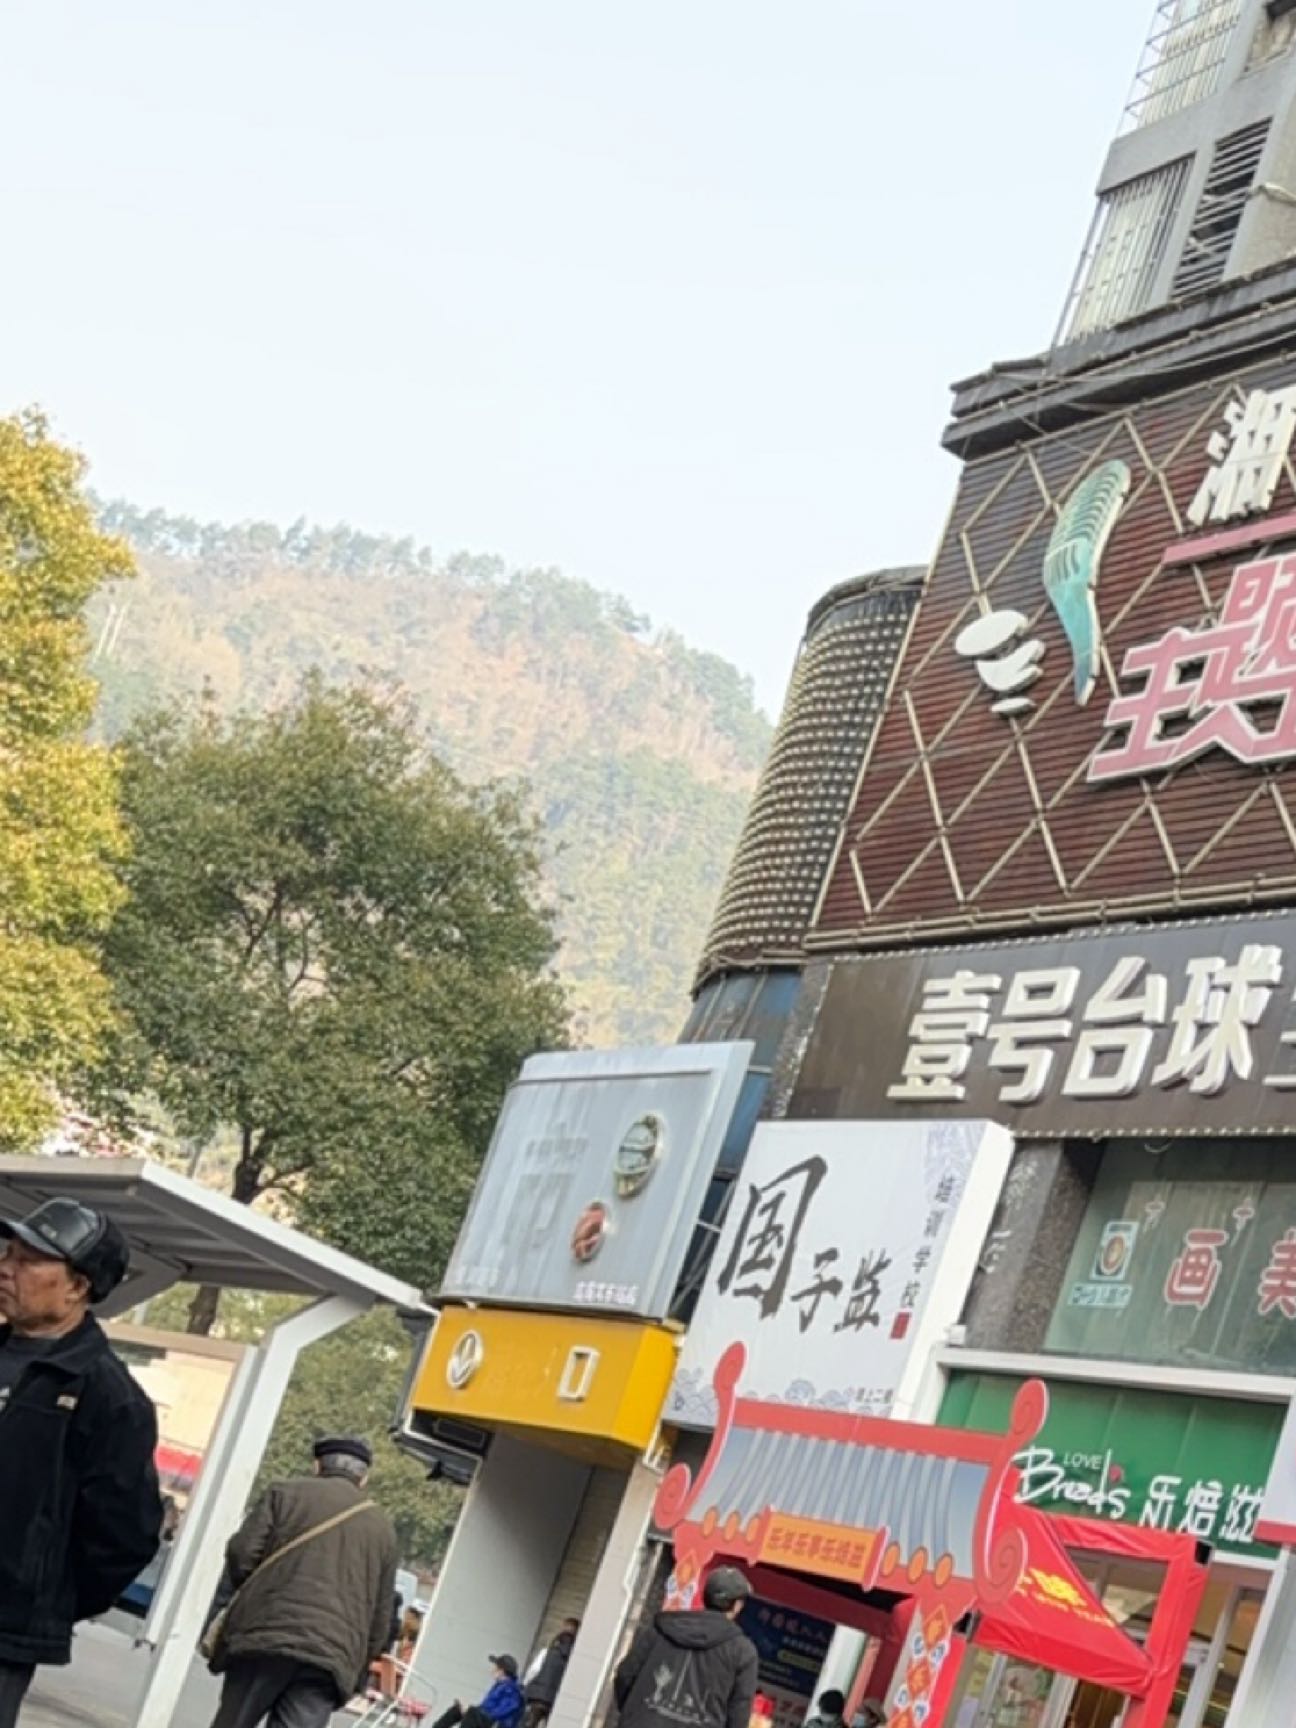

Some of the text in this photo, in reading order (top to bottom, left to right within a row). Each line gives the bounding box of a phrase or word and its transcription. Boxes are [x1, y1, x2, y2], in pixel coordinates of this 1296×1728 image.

[887, 945, 1282, 1104] 壹号台球
[717, 1154, 892, 1334] 国子监
[1063, 1451, 1103, 1470] LOVE
